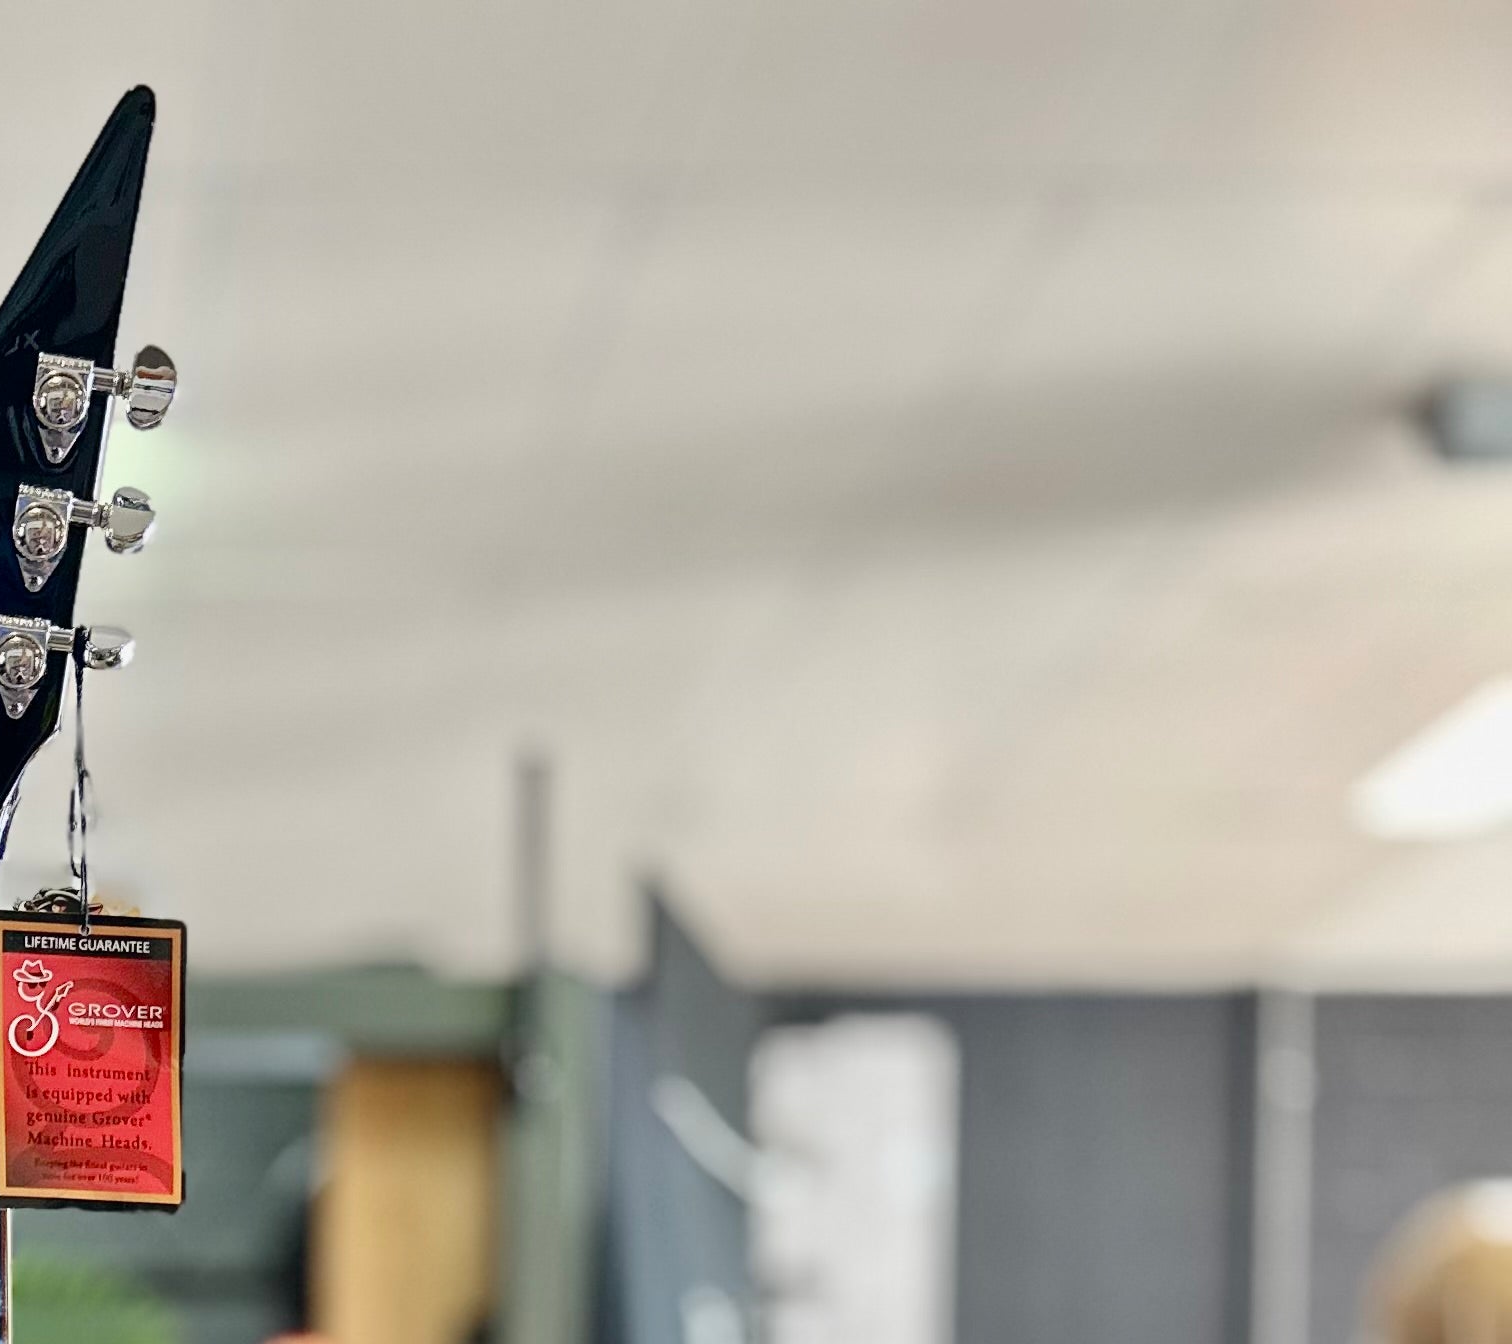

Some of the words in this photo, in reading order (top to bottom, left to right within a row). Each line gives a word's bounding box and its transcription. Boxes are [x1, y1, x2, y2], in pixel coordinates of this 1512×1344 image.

[24, 936, 77, 951] LIFETIME
[78, 938, 151, 954] GUARANTEE
[68, 1002, 163, 1020] GROVER
[25, 1059, 57, 1076] This
[67, 1063, 151, 1081] instrument
[42, 1088, 113, 1105] equipped
[117, 1089, 151, 1104] with
[26, 1109, 87, 1127] genuine
[27, 1131, 93, 1148] Machine
[101, 1134, 153, 1151] Heads.
